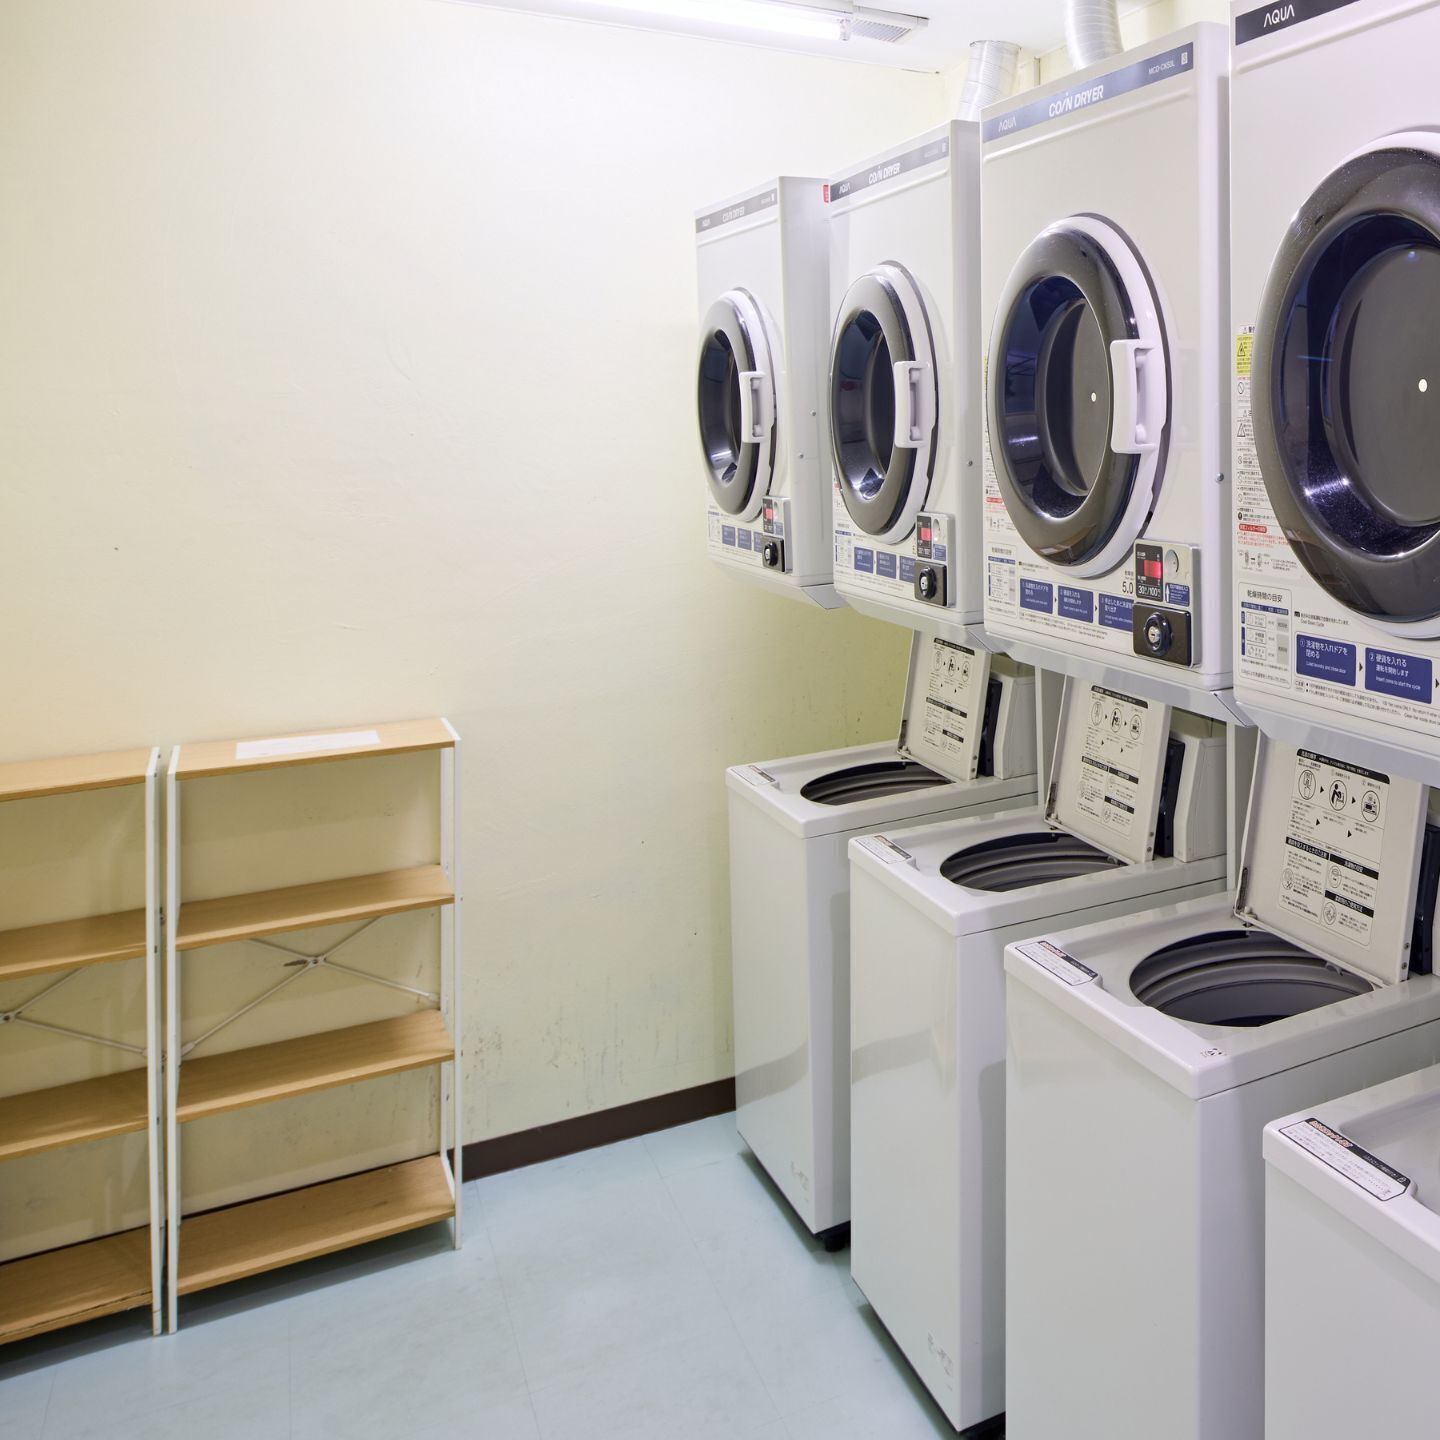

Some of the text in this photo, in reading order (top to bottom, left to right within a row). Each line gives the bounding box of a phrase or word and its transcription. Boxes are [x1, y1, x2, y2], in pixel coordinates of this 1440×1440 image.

[1263, 4, 1295, 27] AQUA
[999, 115, 1017, 133] AQUA
[1074, 85, 1104, 110] DRYER
